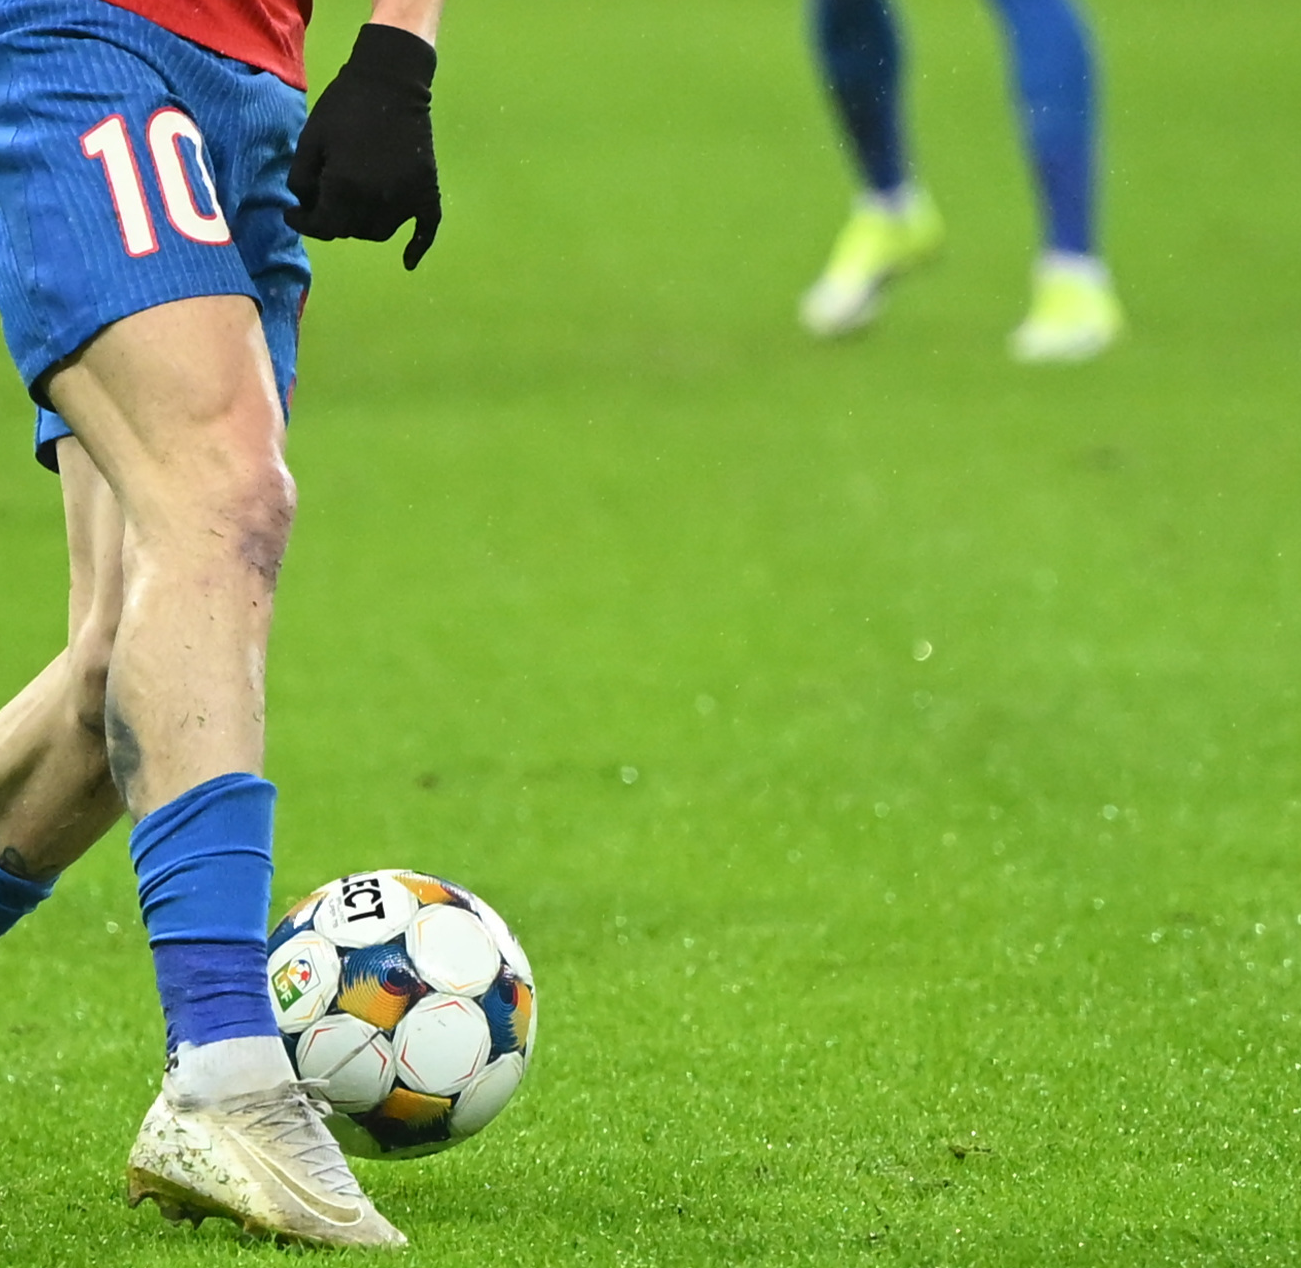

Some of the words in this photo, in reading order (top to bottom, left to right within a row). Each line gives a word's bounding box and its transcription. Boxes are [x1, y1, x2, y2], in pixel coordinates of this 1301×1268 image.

[78, 106, 233, 259] 10
[340, 877, 385, 923] ECT
[272, 971, 294, 1003] LPF
